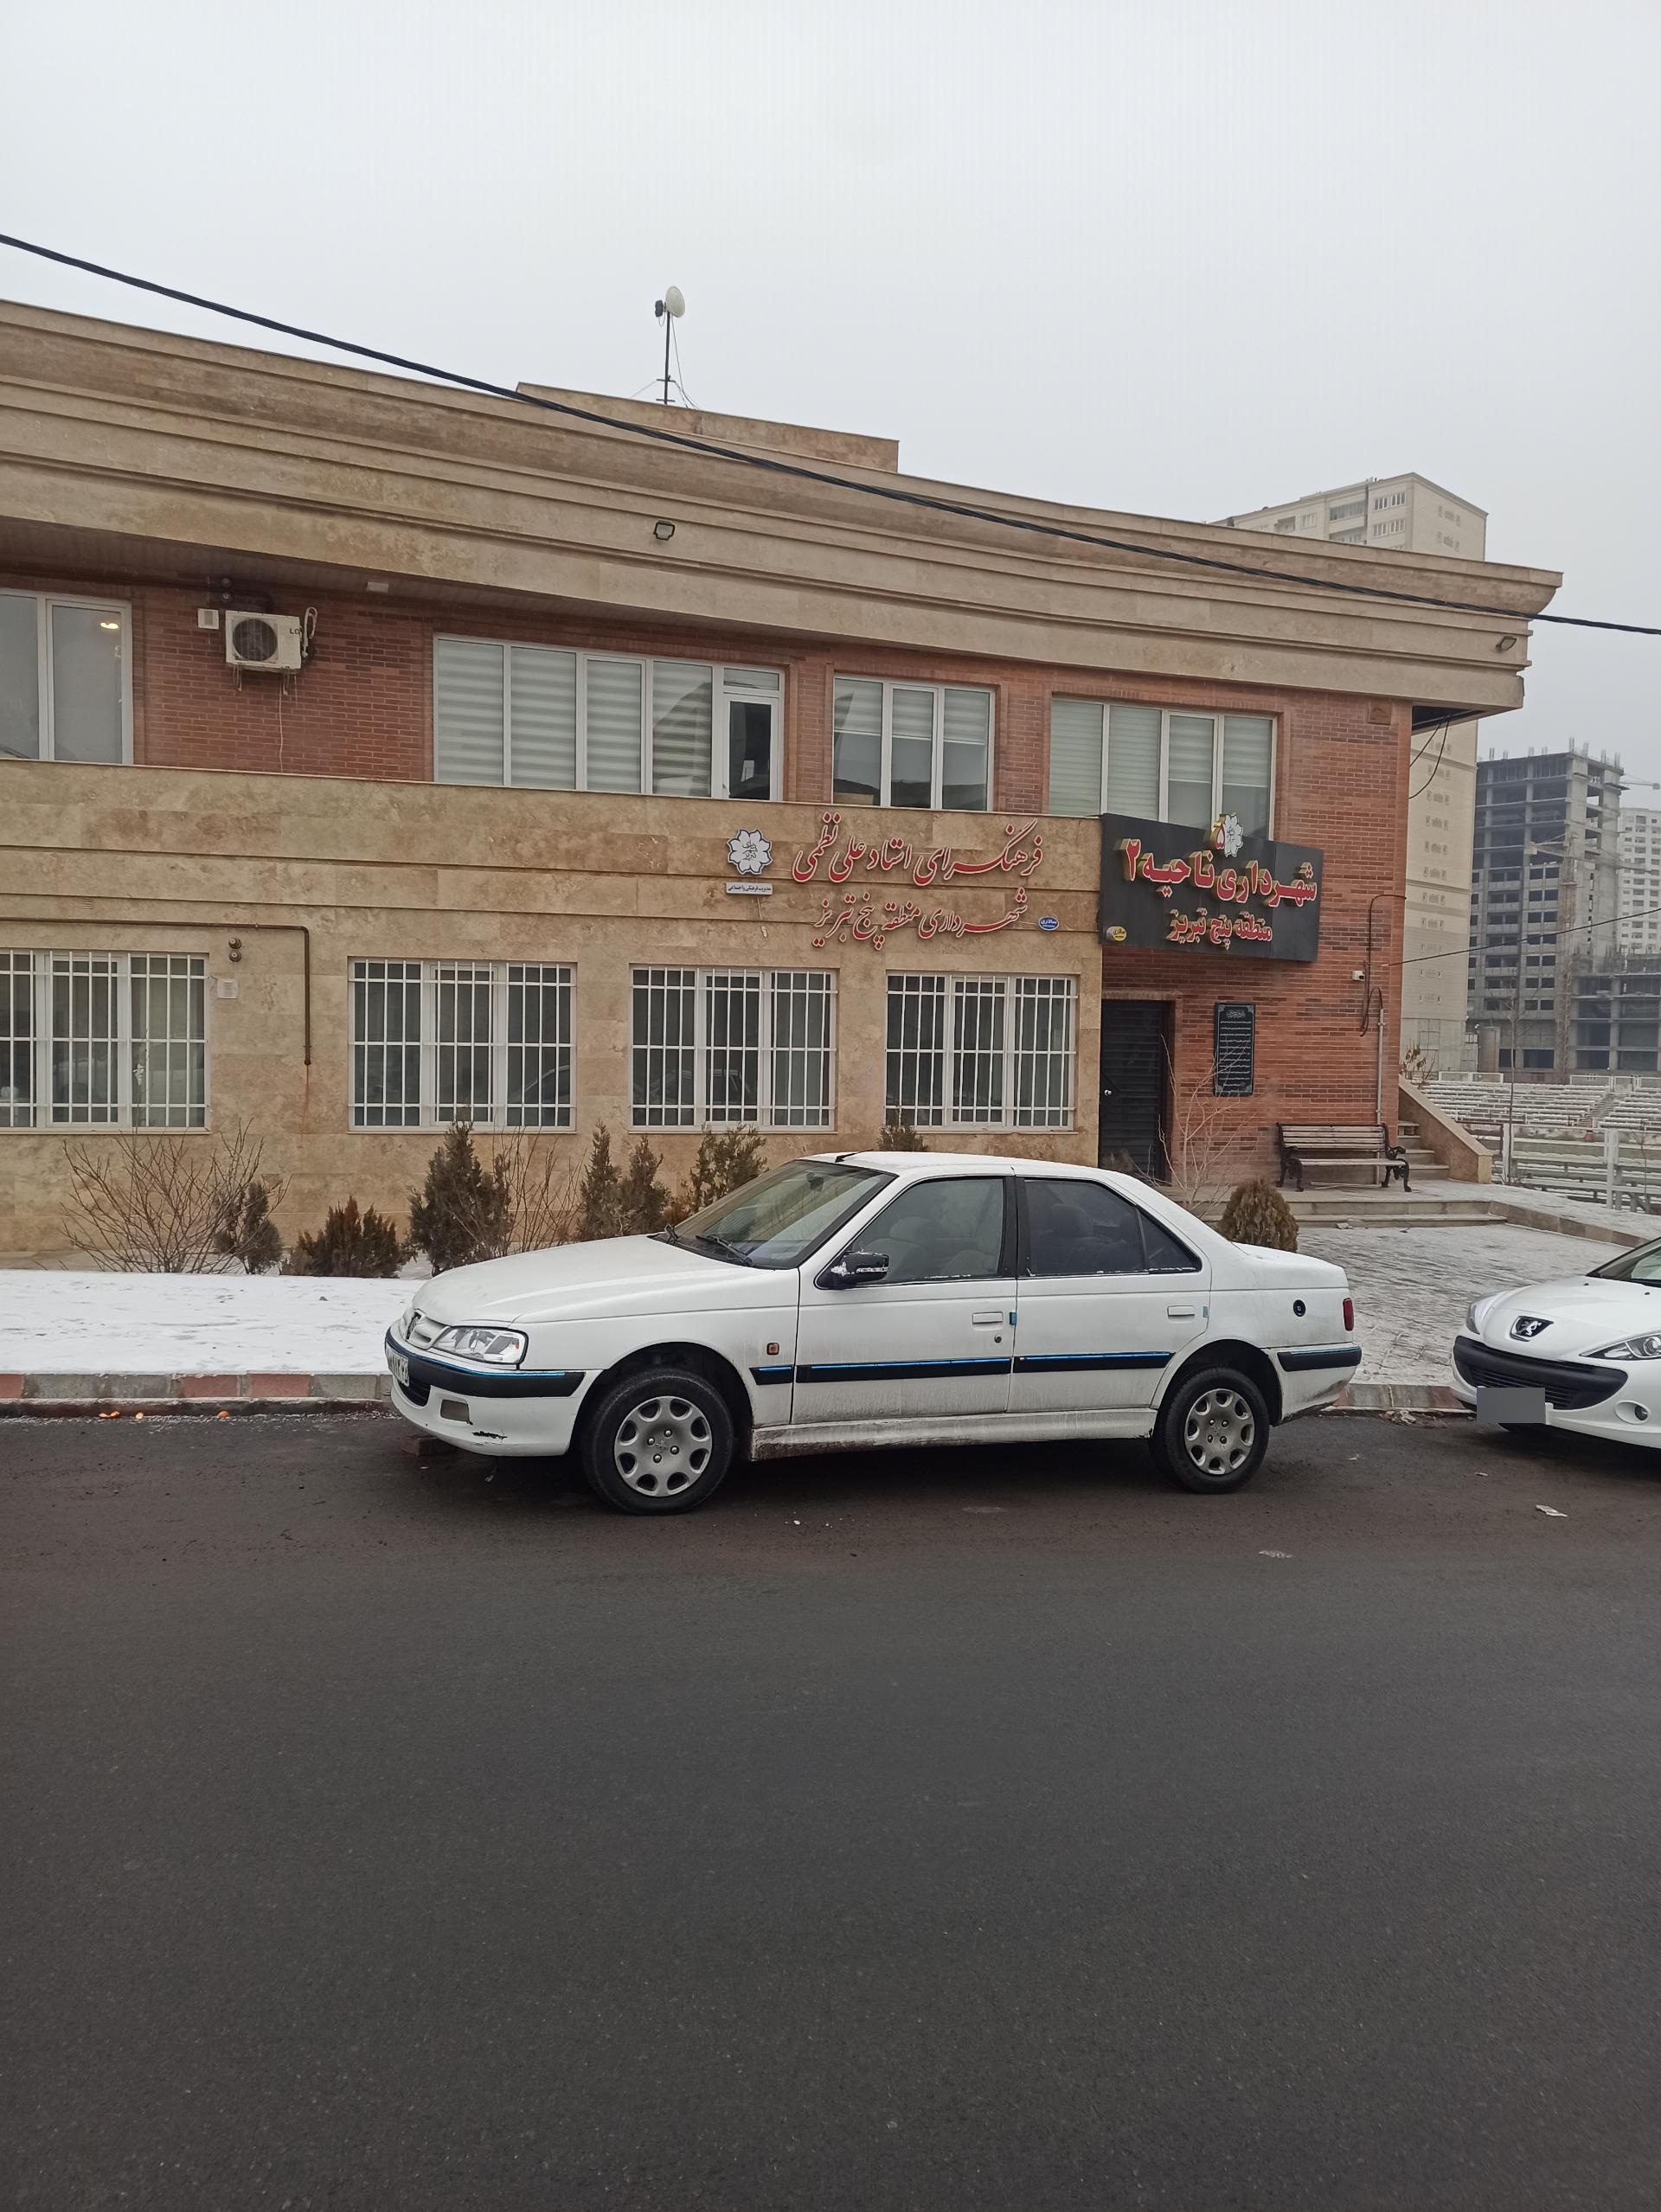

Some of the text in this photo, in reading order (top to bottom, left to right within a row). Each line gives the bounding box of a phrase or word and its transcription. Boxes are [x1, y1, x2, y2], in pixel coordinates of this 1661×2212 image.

[792, 811, 842, 882] نظمی
[829, 836, 868, 883] علی
[867, 837, 913, 870] استاد
[1125, 838, 1318, 907] شهرداری ناحیه ۲
[812, 887, 1028, 950] شهرداری منطقه پنج تبریز
[1169, 907, 1273, 950] منطقه پنج تبریز
